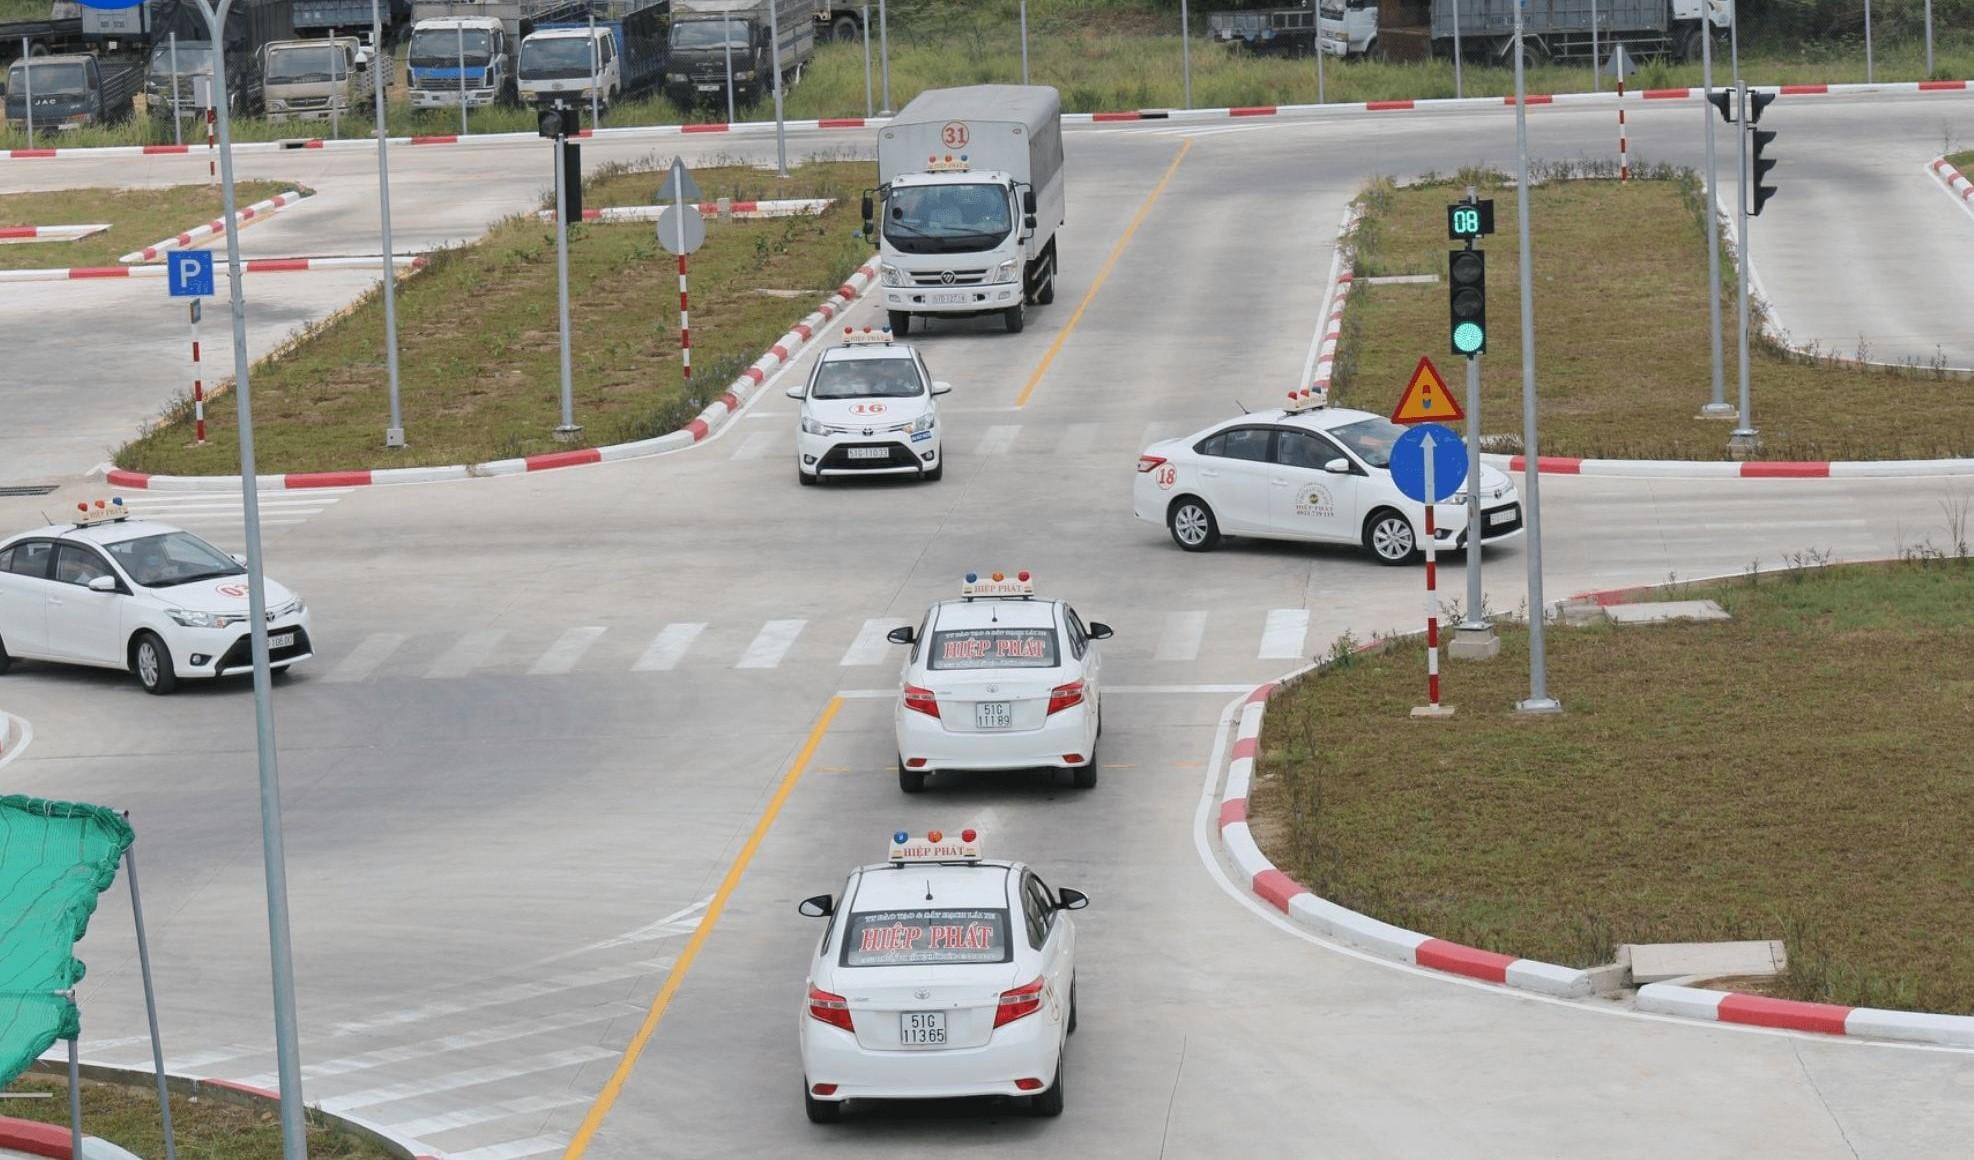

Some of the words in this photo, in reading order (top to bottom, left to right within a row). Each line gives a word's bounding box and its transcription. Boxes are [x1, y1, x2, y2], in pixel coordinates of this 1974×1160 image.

[35, 98, 57, 106] JAC
[945, 127, 966, 144] 31
[1453, 210, 1479, 233] 08
[180, 259, 201, 288] P
[855, 404, 884, 413] 16
[1159, 468, 1176, 485] 18
[943, 637, 992, 660] HIỆP
[995, 636, 1046, 658] PHÁT
[984, 704, 1002, 715] 51G
[903, 845, 931, 858] HIỆP
[934, 844, 964, 856] PHÁT
[859, 921, 922, 954] HIỆP
[928, 921, 994, 951] PHÁT
[911, 1014, 935, 1028] 51G
